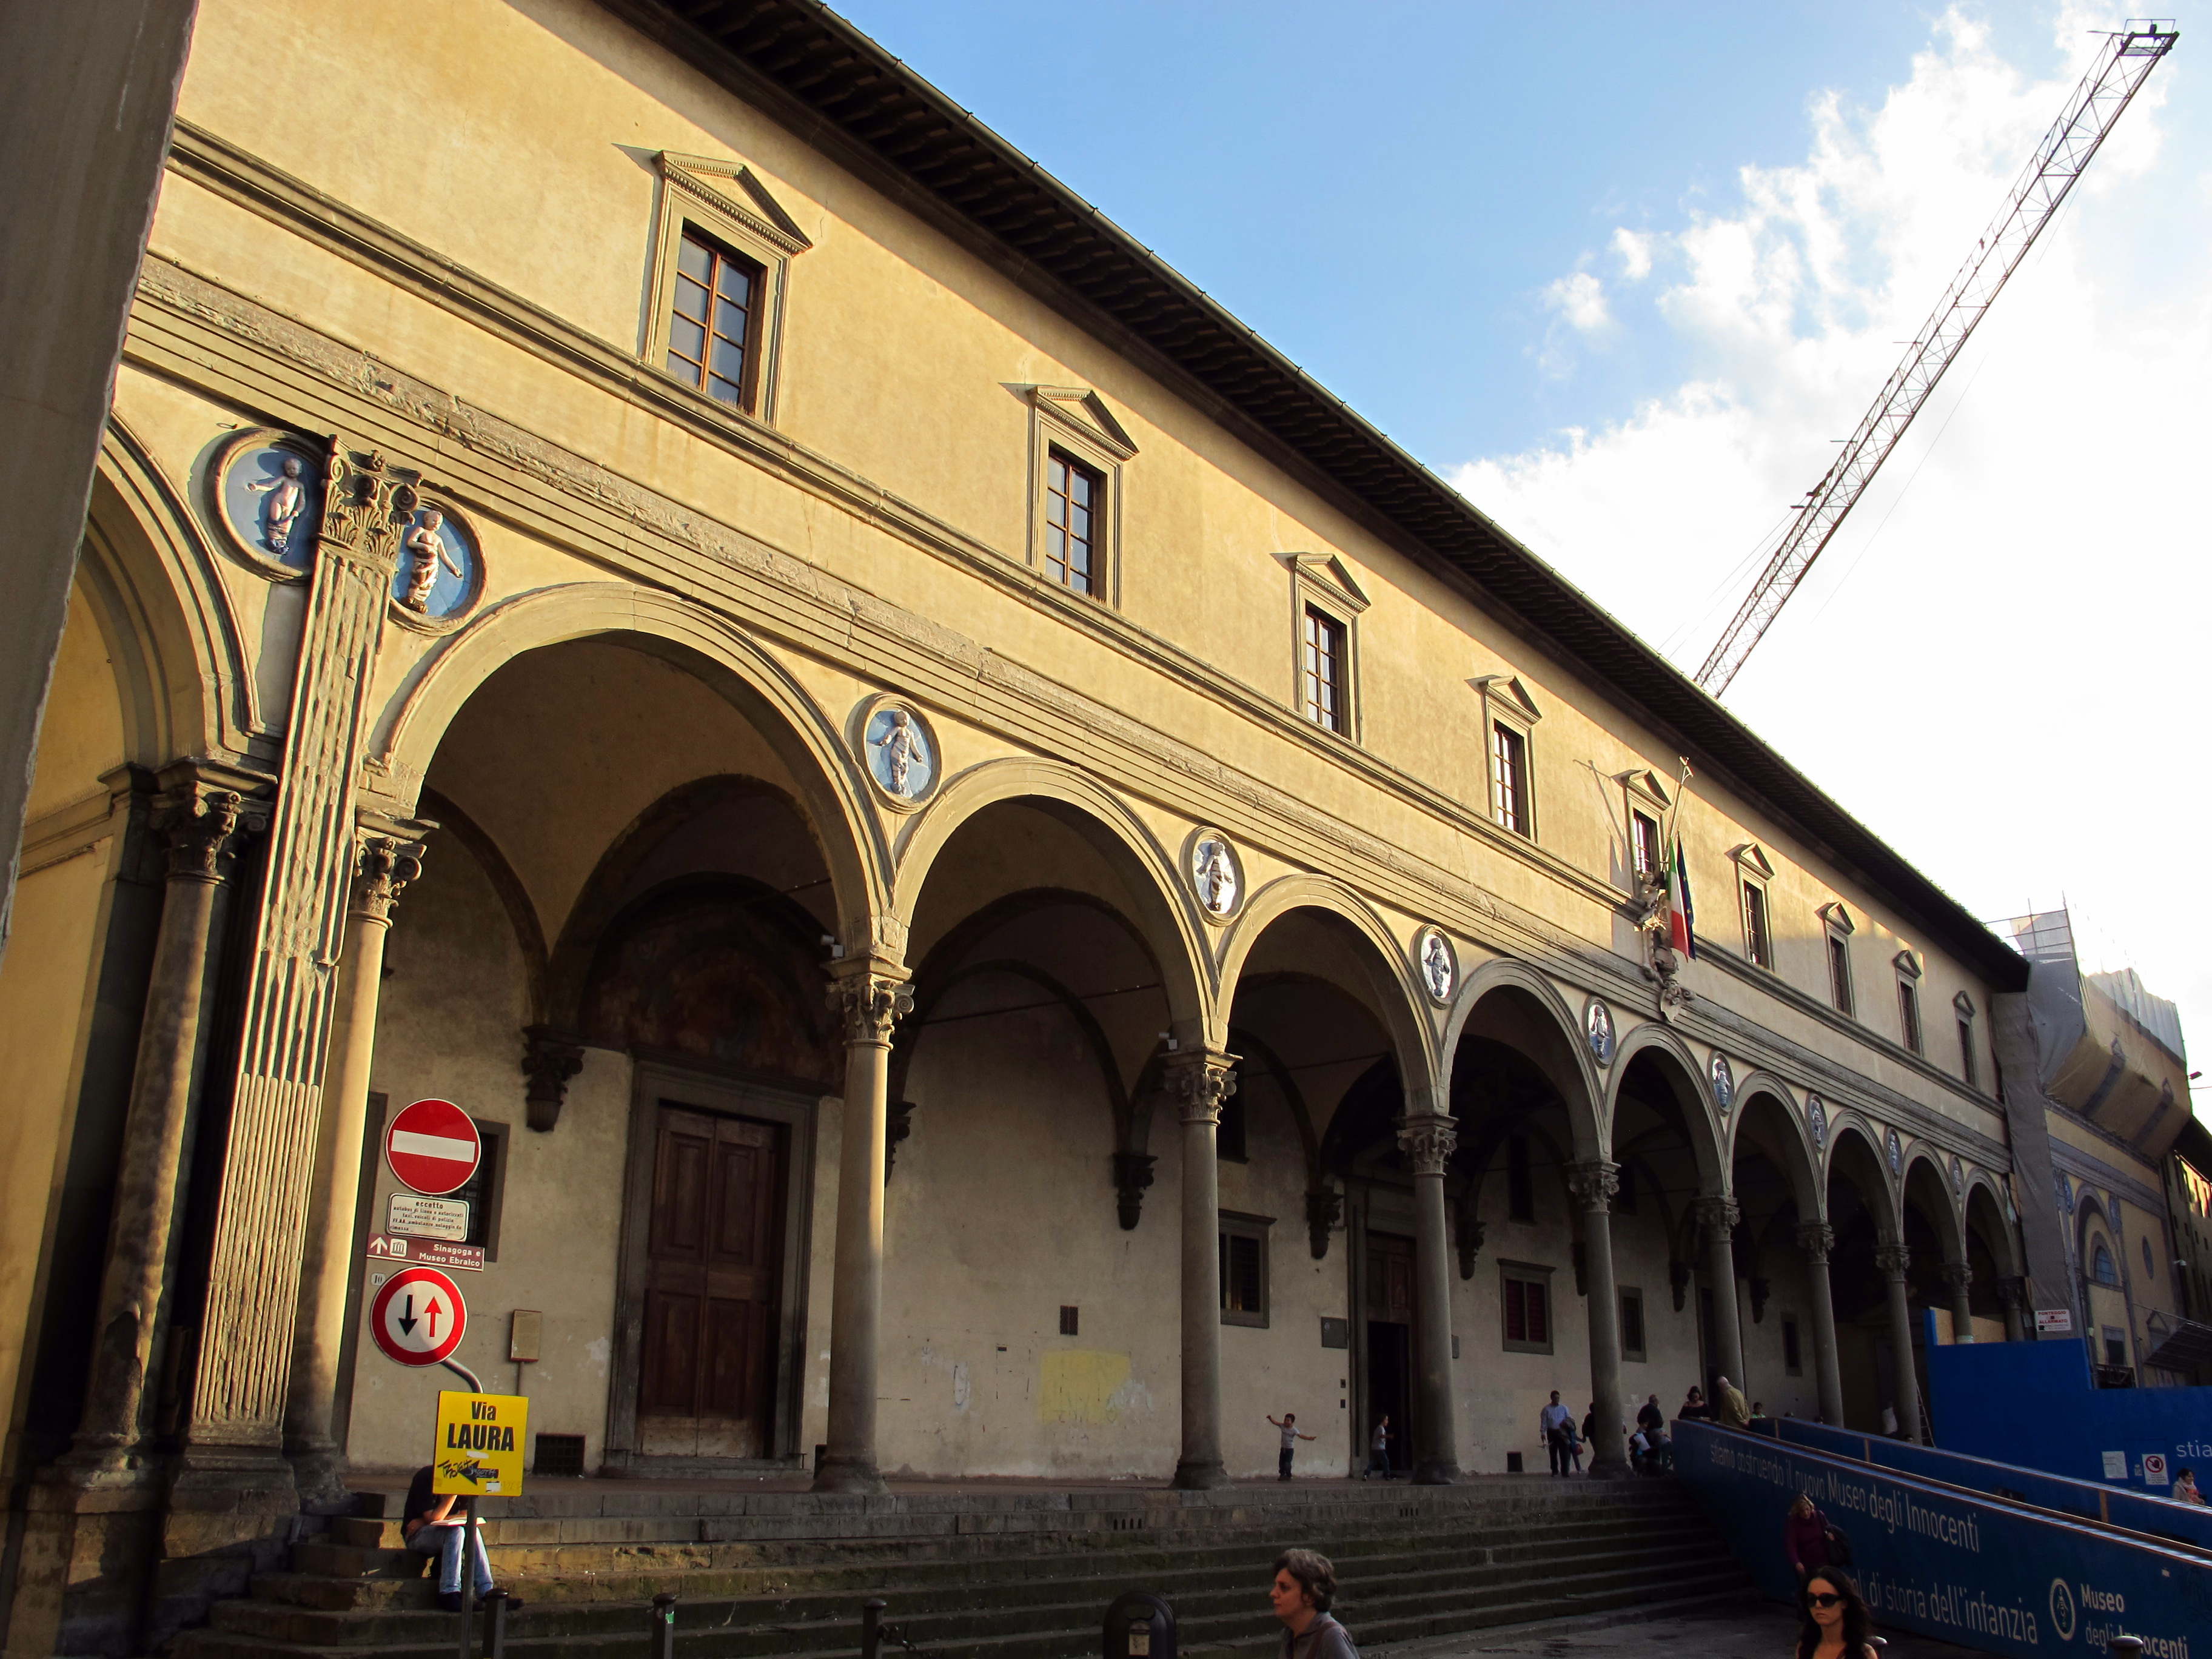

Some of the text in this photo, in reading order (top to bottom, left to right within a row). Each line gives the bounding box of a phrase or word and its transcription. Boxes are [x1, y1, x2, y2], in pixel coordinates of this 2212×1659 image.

[419, 1252, 480, 1267] Museo Ebraico
[433, 1244, 472, 1256] Sinagoga
[471, 1401, 497, 1421] Via
[447, 1423, 514, 1452] LAURA
[2176, 1439, 2212, 1458] stia
[1710, 1439, 1980, 1553] stiamo costruendo il nuovo Museo degli Innocenti
[1869, 1572, 1882, 1608] di
[1885, 1578, 1926, 1619] storia
[1930, 1582, 2038, 1645] dell'infanzia
[2080, 1583, 2125, 1613] Museo
[2085, 1620, 2114, 1655] degli
